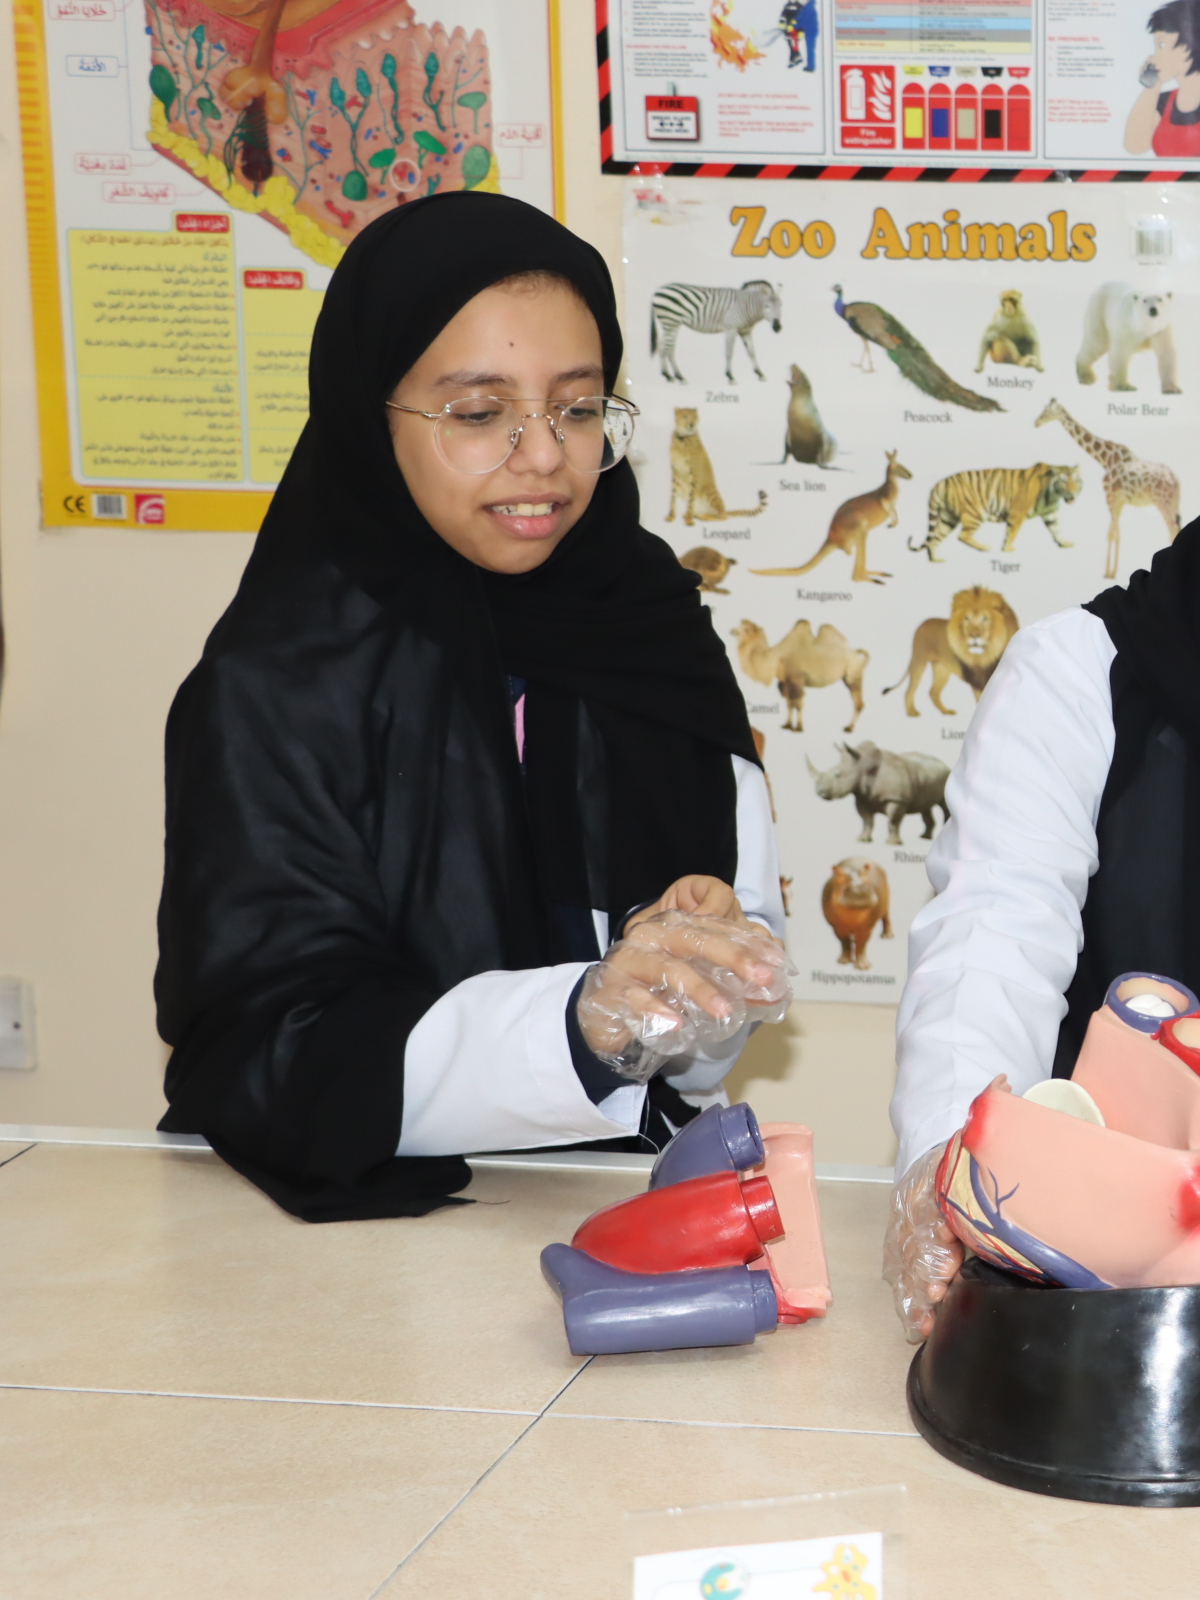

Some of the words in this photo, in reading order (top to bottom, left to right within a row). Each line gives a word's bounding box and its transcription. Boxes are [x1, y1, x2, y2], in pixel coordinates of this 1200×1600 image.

[658, 99, 684, 109] FIRE
[860, 128, 877, 137] Fire
[844, 136, 892, 147] extinguisher
[730, 205, 836, 259] Zoo
[860, 207, 1097, 262] Animals
[986, 374, 1035, 392] Monkey
[704, 391, 740, 404] Zebra
[1106, 402, 1134, 416] Polar
[1138, 402, 1170, 416] Bear
[903, 410, 953, 425] Peacock
[779, 478, 799, 493] Sea
[802, 478, 827, 493] lion
[63, 495, 86, 513] CE
[702, 527, 752, 543] Leopard
[990, 558, 1021, 575] Tiger
[796, 587, 853, 604] Kangaroo
[810, 970, 897, 987] Hippopotamus
